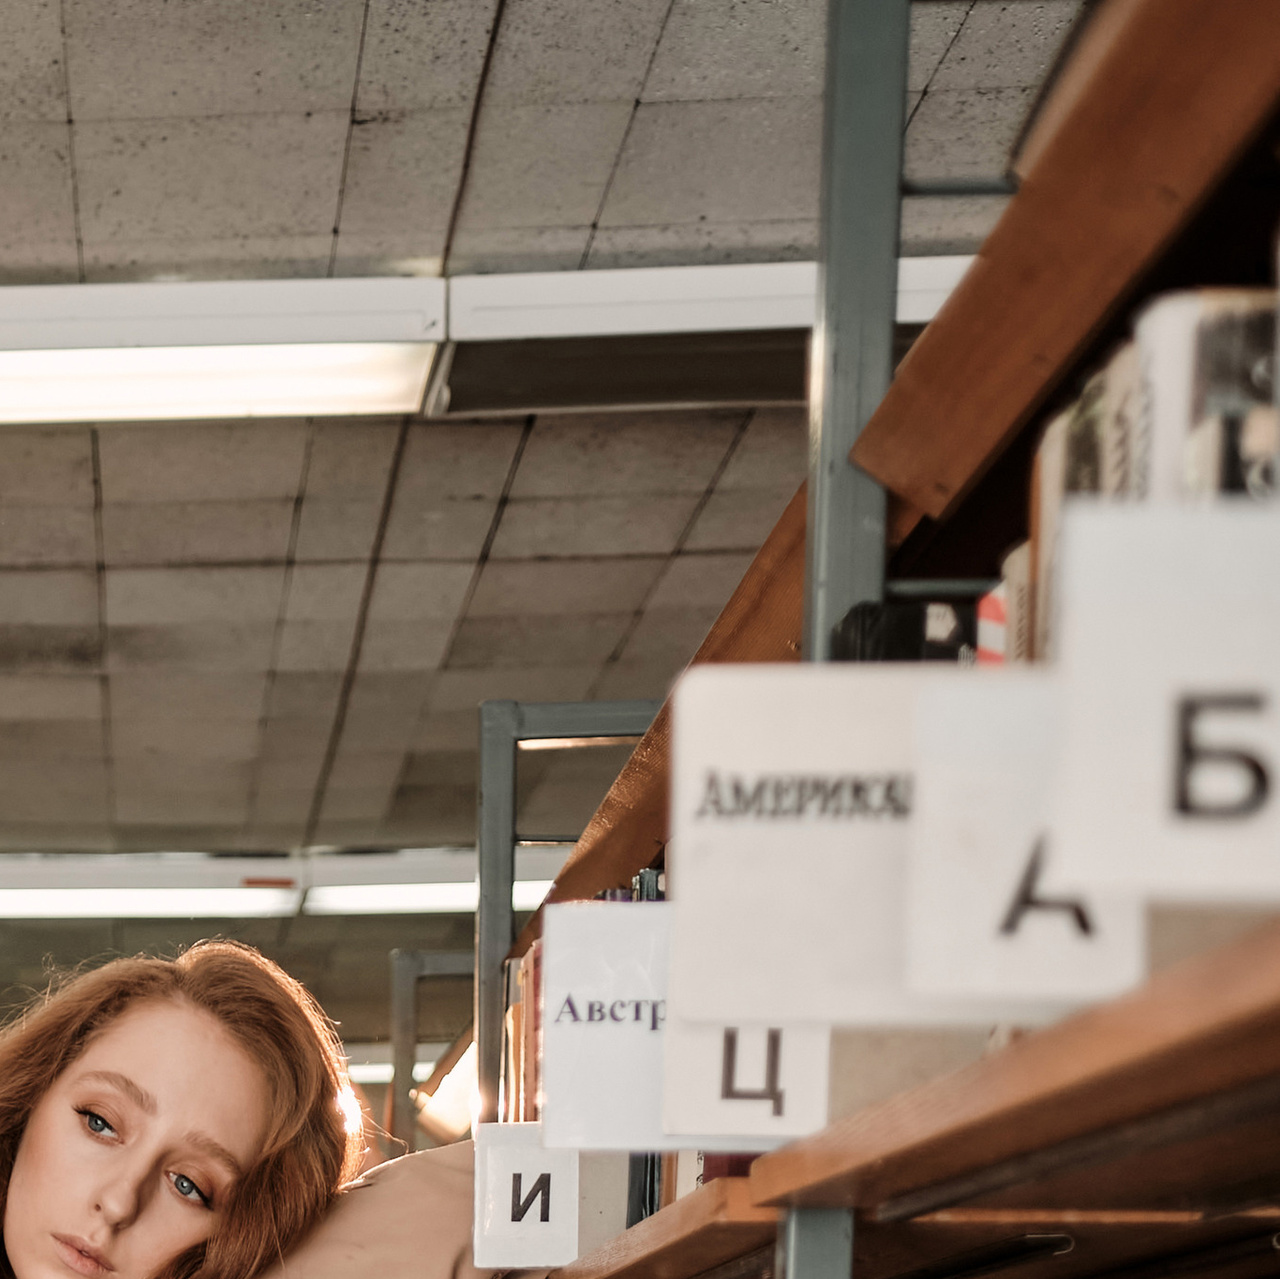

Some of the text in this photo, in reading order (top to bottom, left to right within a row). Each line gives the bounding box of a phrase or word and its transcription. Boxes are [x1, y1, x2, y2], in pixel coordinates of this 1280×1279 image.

[1172, 692, 1270, 820] Б
[554, 990, 668, 1031] Австр
[721, 1025, 786, 1118] Ц
[510, 1171, 552, 1223] И
